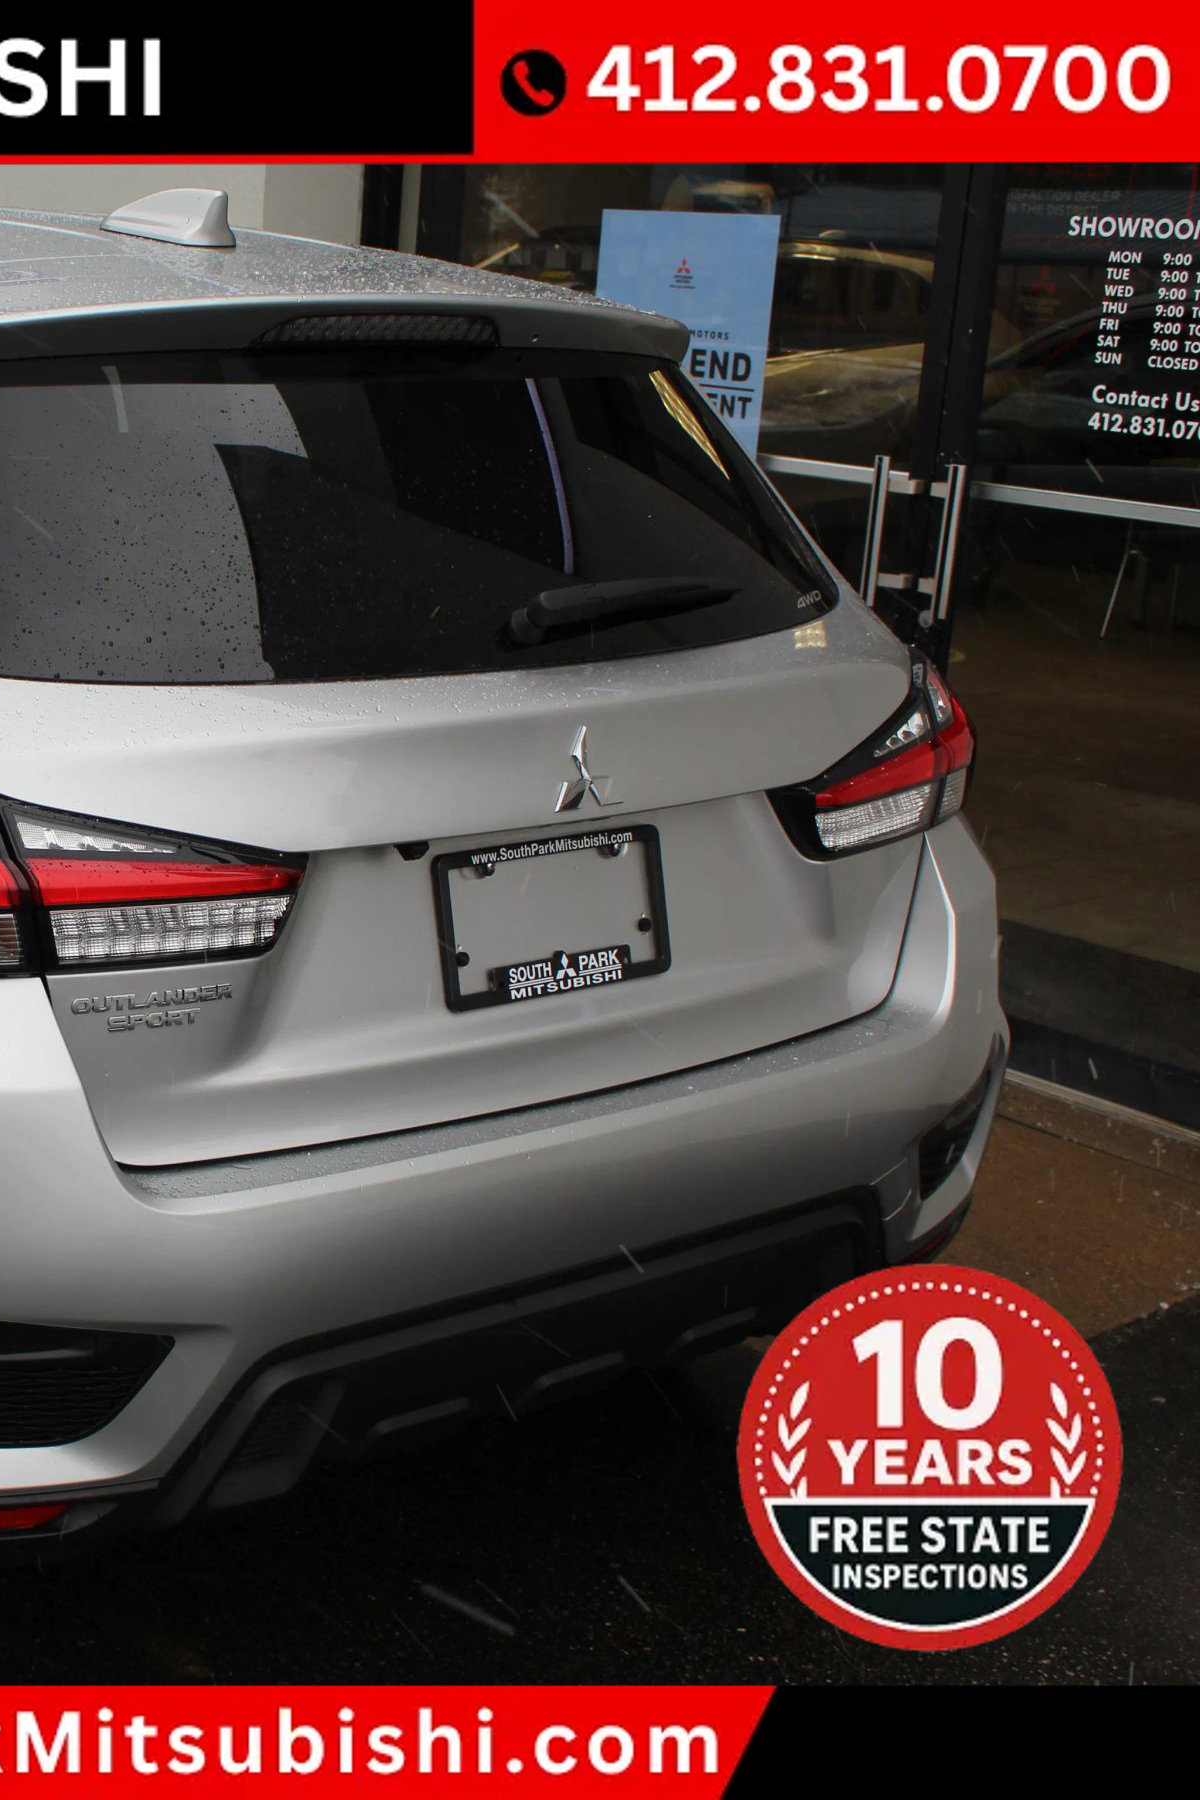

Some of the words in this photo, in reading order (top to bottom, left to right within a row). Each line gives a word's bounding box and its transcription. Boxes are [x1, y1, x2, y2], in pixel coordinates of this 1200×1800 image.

[1108, 251, 1142, 264] MON
[1162, 252, 1193, 266] 9:00
[1106, 267, 1131, 281] TUE
[1160, 270, 1189, 284] 9:00
[1104, 284, 1134, 298] WED
[1157, 287, 1187, 301] 9:00
[1101, 301, 1128, 315] THU
[1155, 304, 1185, 318] 9:00
[1099, 318, 1120, 331] FRI
[1152, 321, 1181, 335] 9:00
[1096, 334, 1121, 348] SAT
[1150, 338, 1178, 352] 9:00
[1184, 341, 1200, 354] TO
[1094, 351, 1123, 365] SUN
[1147, 355, 1199, 371] CLOSED
[1091, 384, 1169, 410] Contact
[1174, 391, 1200, 413] Us
[1087, 411, 1200, 440] 412.831.07
[797, 589, 822, 609] 4WD
[470, 831, 633, 865] www.SouthParkMitsubishi.com
[508, 962, 553, 984] SOUTH
[578, 949, 622, 971] PARK
[510, 969, 623, 1001] MITSUBISHI
[70, 982, 233, 1015] OUTLANDER
[107, 1007, 200, 1033] SPORT
